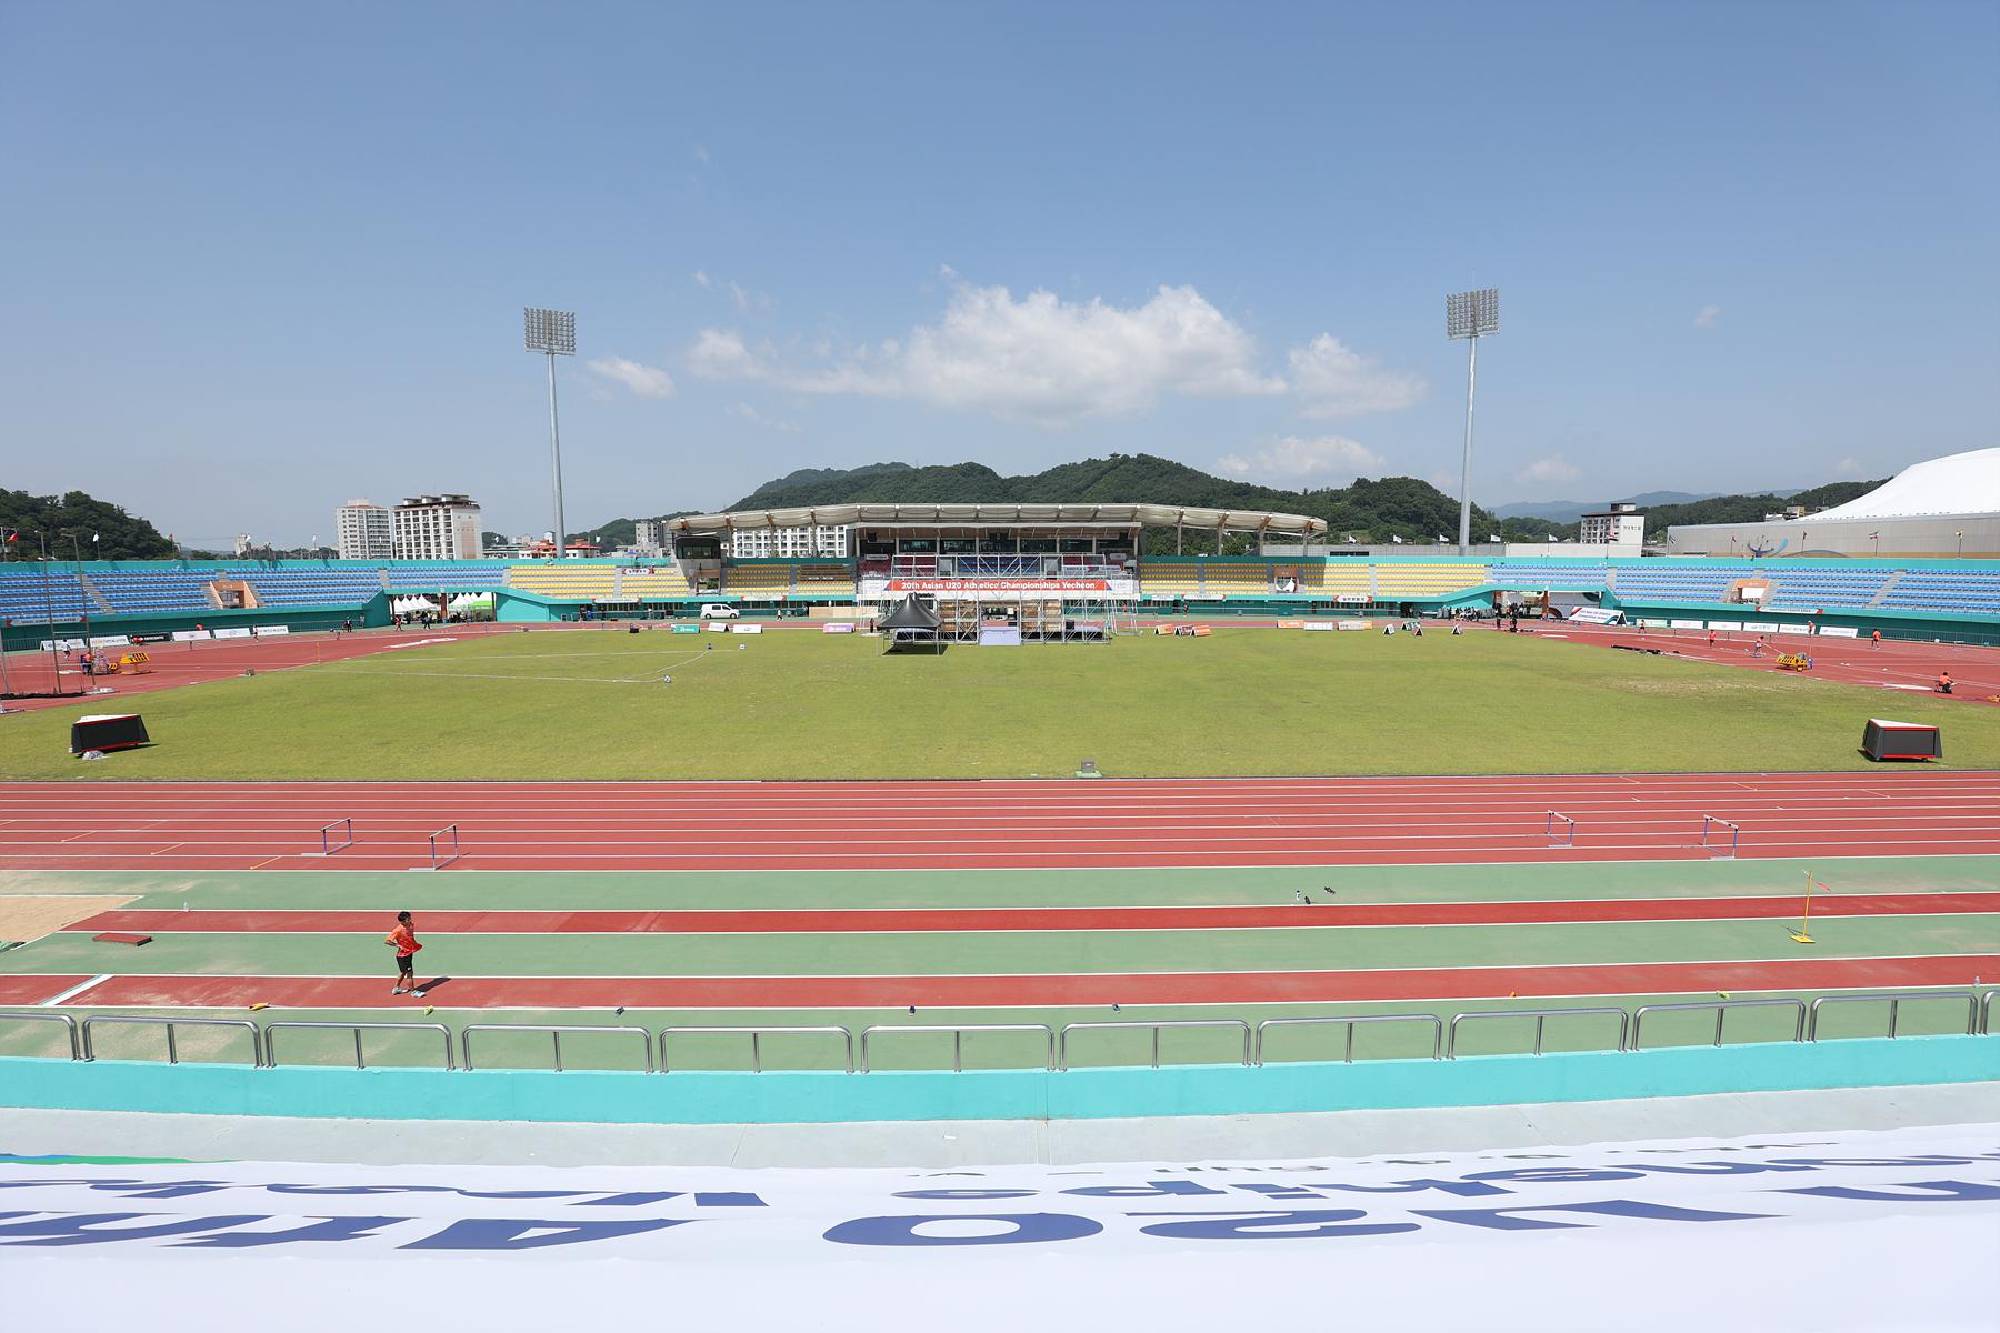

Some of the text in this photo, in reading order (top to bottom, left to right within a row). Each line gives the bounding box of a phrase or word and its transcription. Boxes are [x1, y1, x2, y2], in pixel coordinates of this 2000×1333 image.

[901, 582, 1095, 591] 20th Asian U20 Athletics Championships Yecheon
[822, 1200, 1788, 1246] U20
